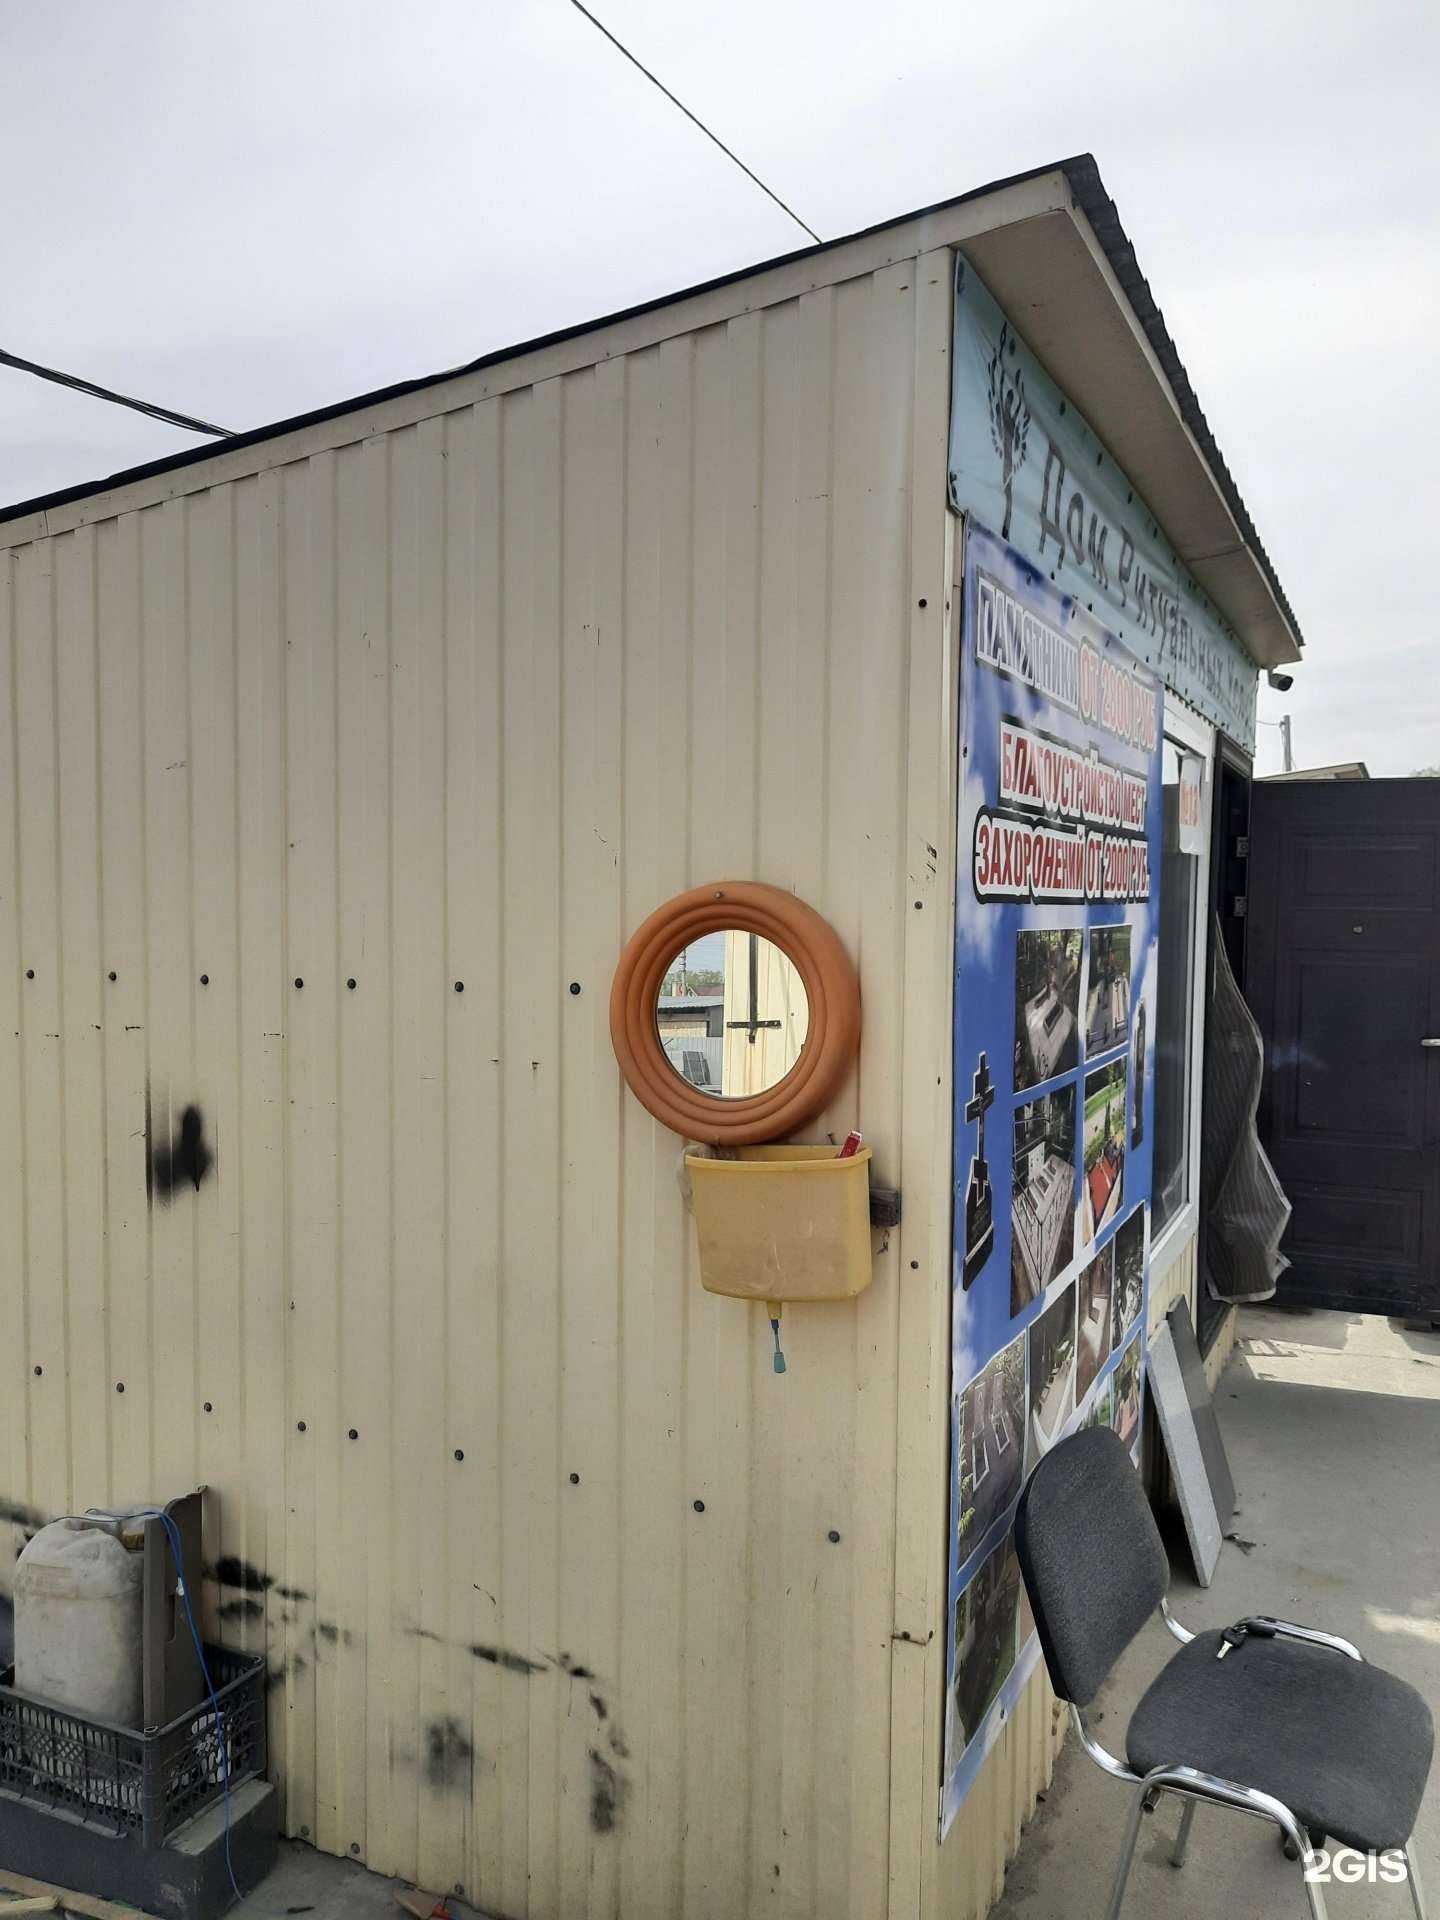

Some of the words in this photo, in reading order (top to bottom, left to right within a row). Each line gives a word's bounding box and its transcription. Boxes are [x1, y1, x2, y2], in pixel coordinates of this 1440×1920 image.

[1039, 441, 1108, 590] Дом
[977, 577, 1079, 712] ПАМЯТНИКИ
[1080, 644, 1099, 722] ОТ
[1002, 731, 1121, 821] БЛАГОУСТРОЙСТВО
[1122, 778, 1145, 826] МЕСТ
[978, 824, 1084, 891] ЗАХОРОНЕНИЙ
[1086, 837, 1102, 893] ОТ
[1103, 840, 1129, 893] 2000
